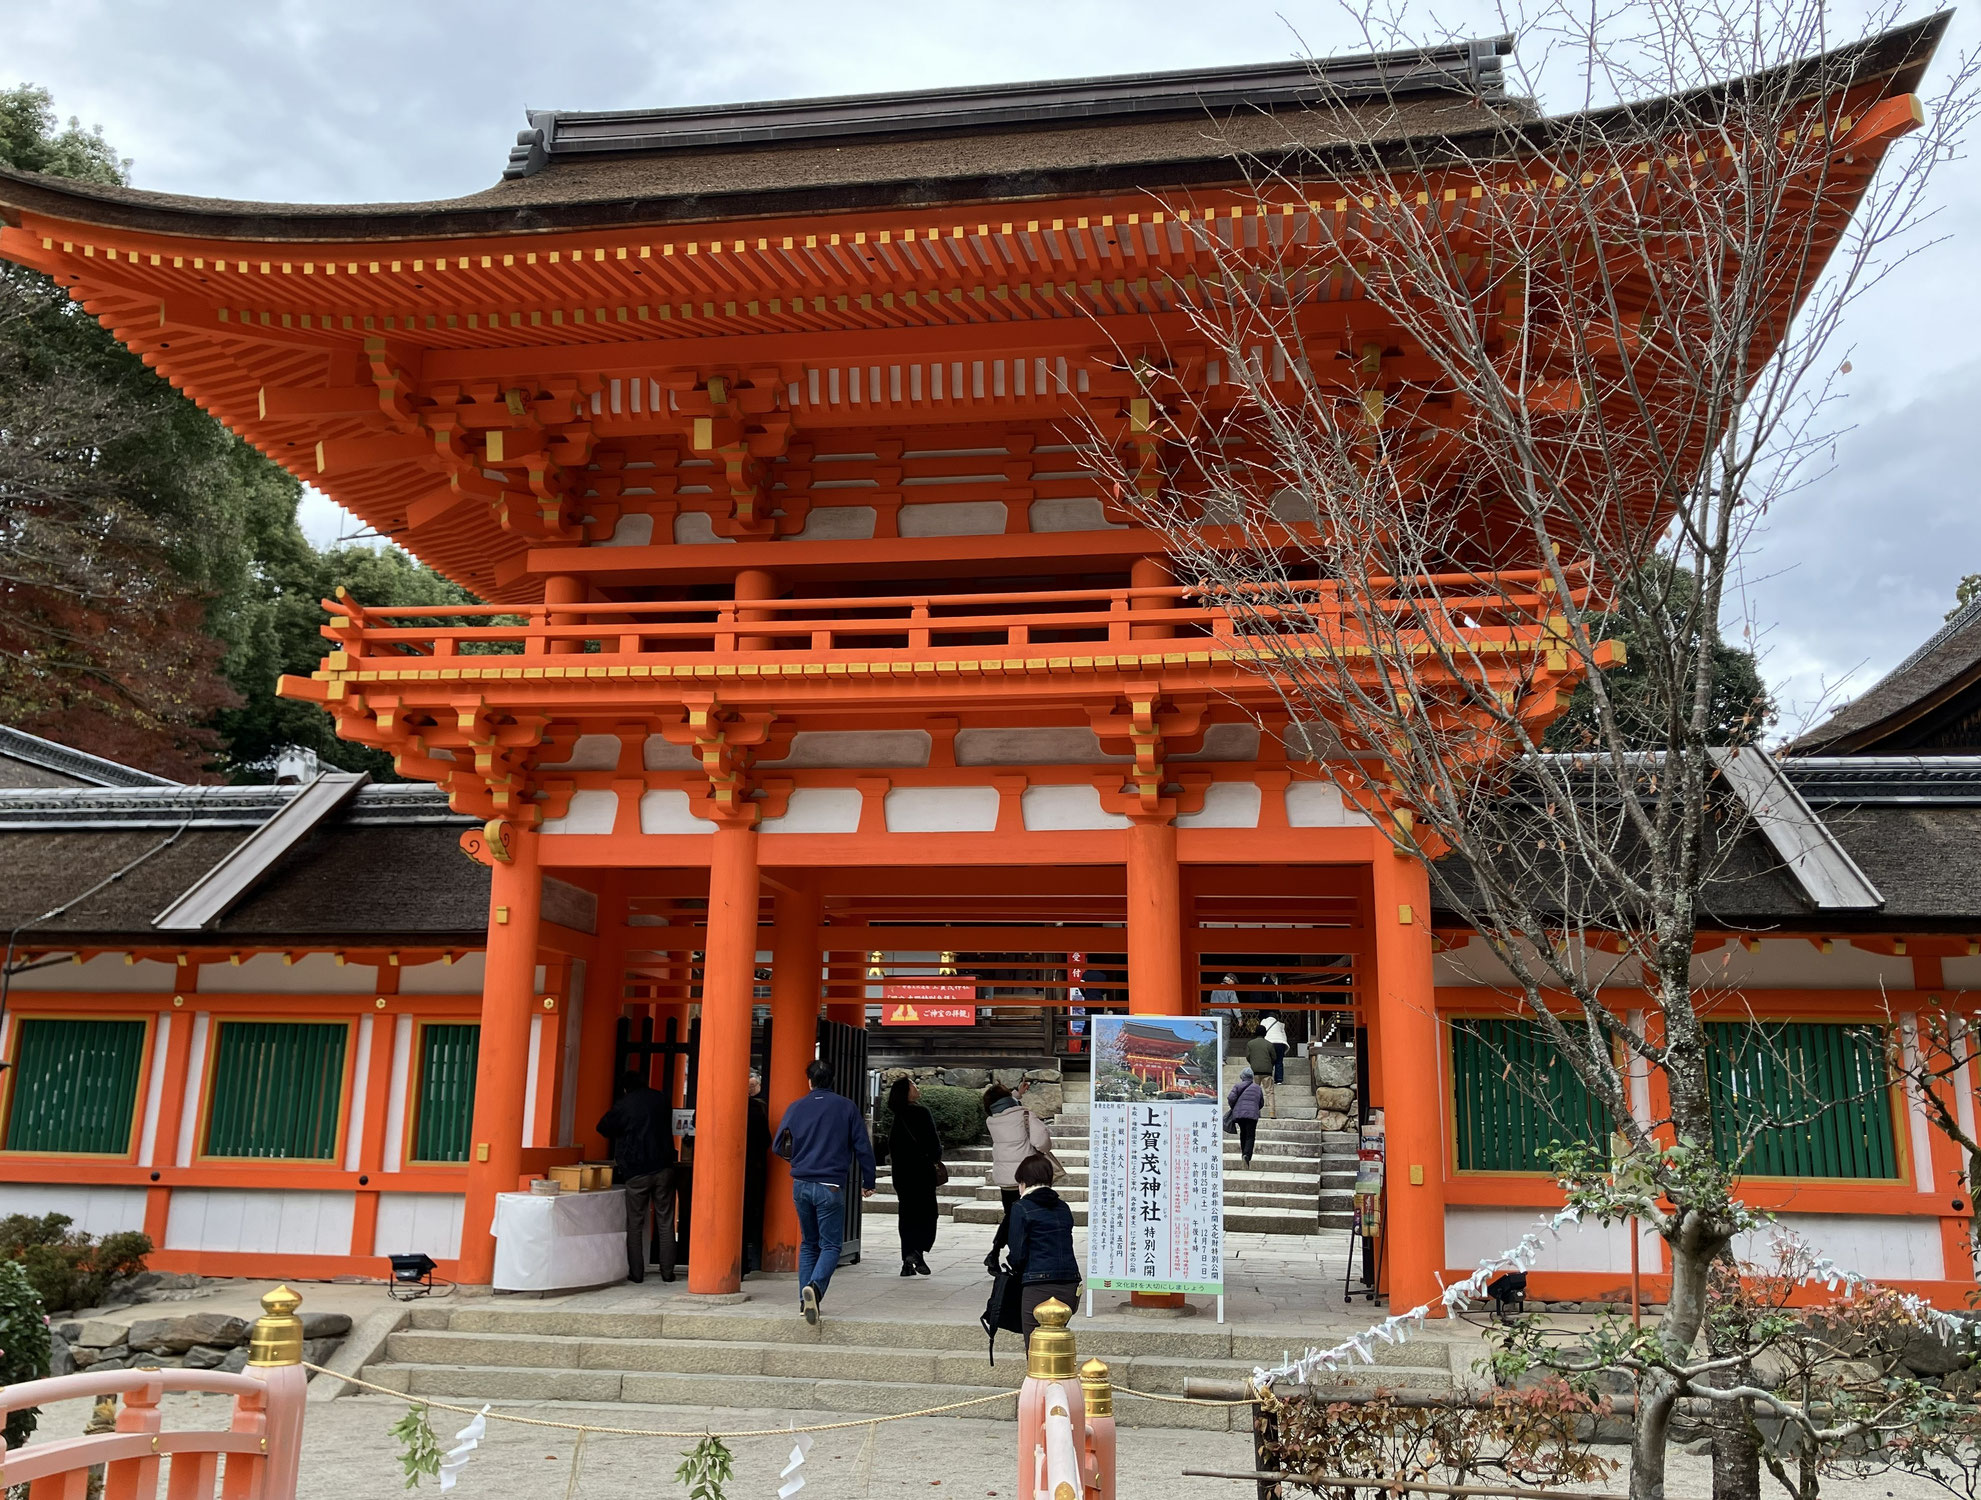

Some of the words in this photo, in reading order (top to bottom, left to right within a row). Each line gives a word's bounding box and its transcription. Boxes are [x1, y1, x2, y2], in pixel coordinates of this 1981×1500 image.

[1072, 952, 1081, 978] 受付
[1117, 1154, 1124, 1169] 大人
[1140, 1107, 1161, 1222] 上賀茂神社
[1210, 1155, 1218, 1178] 第61回
[1143, 1226, 1156, 1277] 特別公開
[1115, 1281, 1205, 1291] 文化財を大切にしましょう
